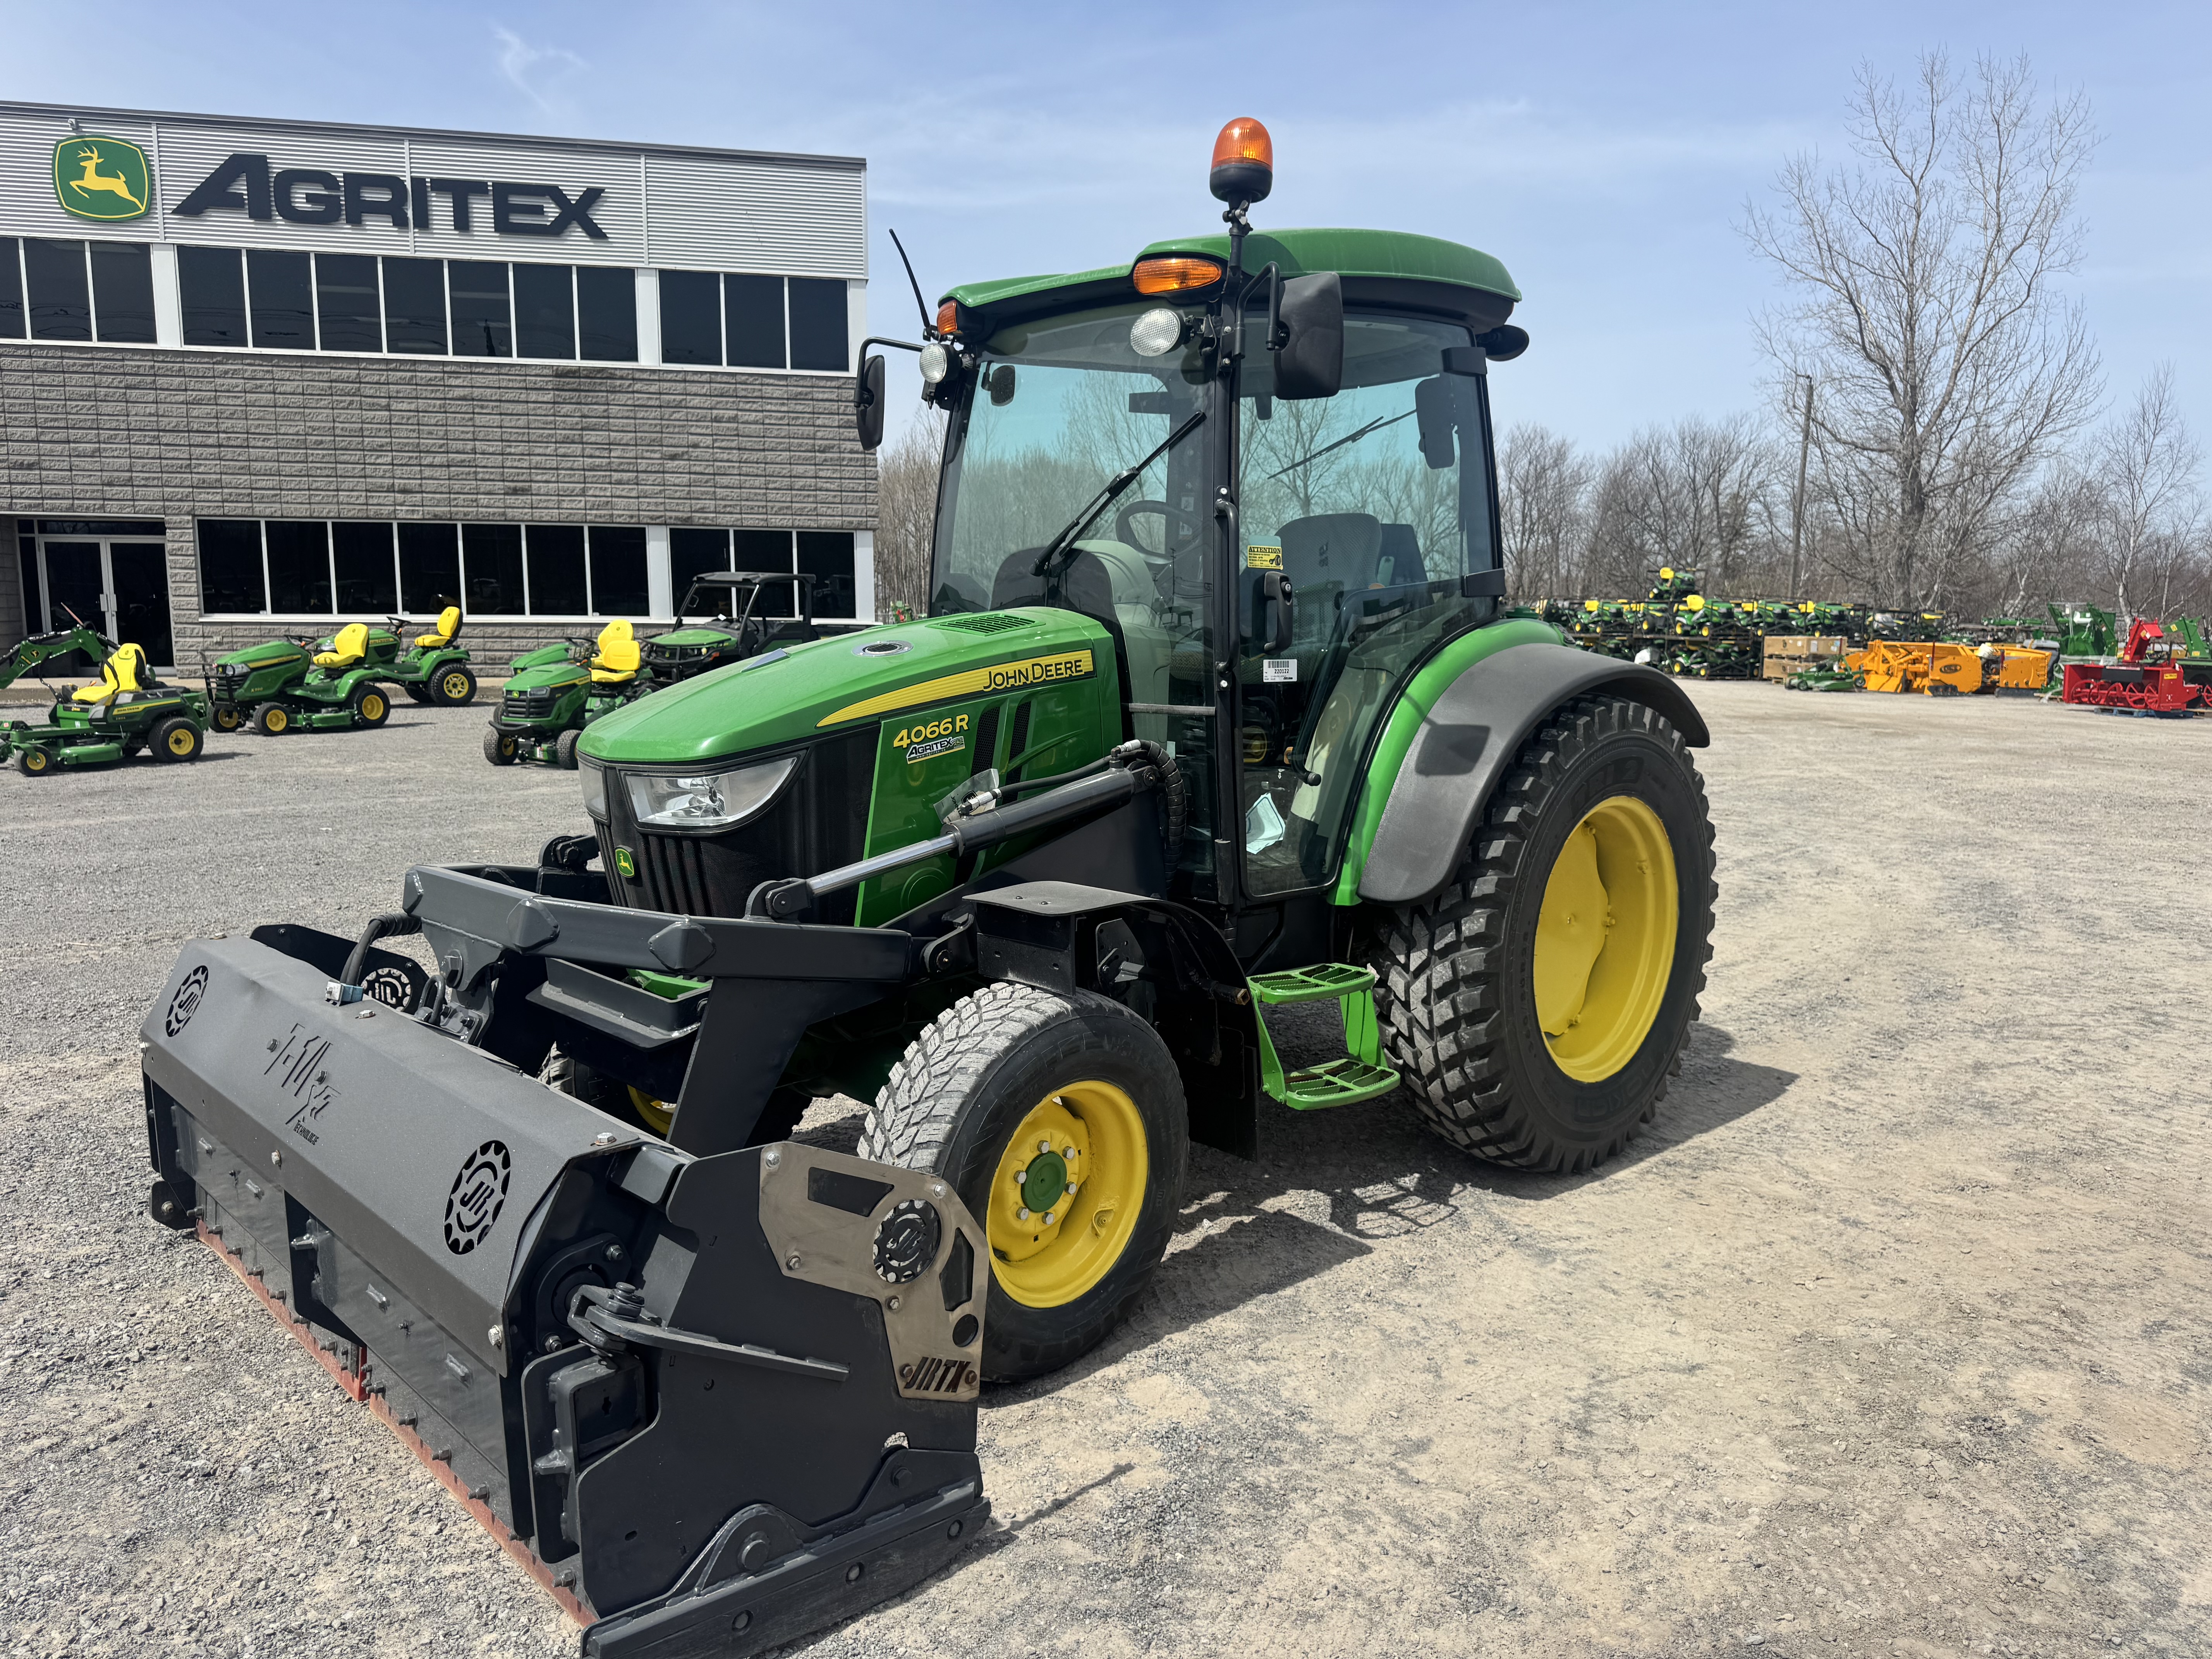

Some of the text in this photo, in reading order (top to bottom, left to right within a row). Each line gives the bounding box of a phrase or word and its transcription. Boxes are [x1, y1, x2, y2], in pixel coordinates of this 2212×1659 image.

[171, 153, 609, 239] AGRITEX
[983, 659, 1083, 690] JOHN DEERE
[908, 738, 952, 757] AGRITEX
